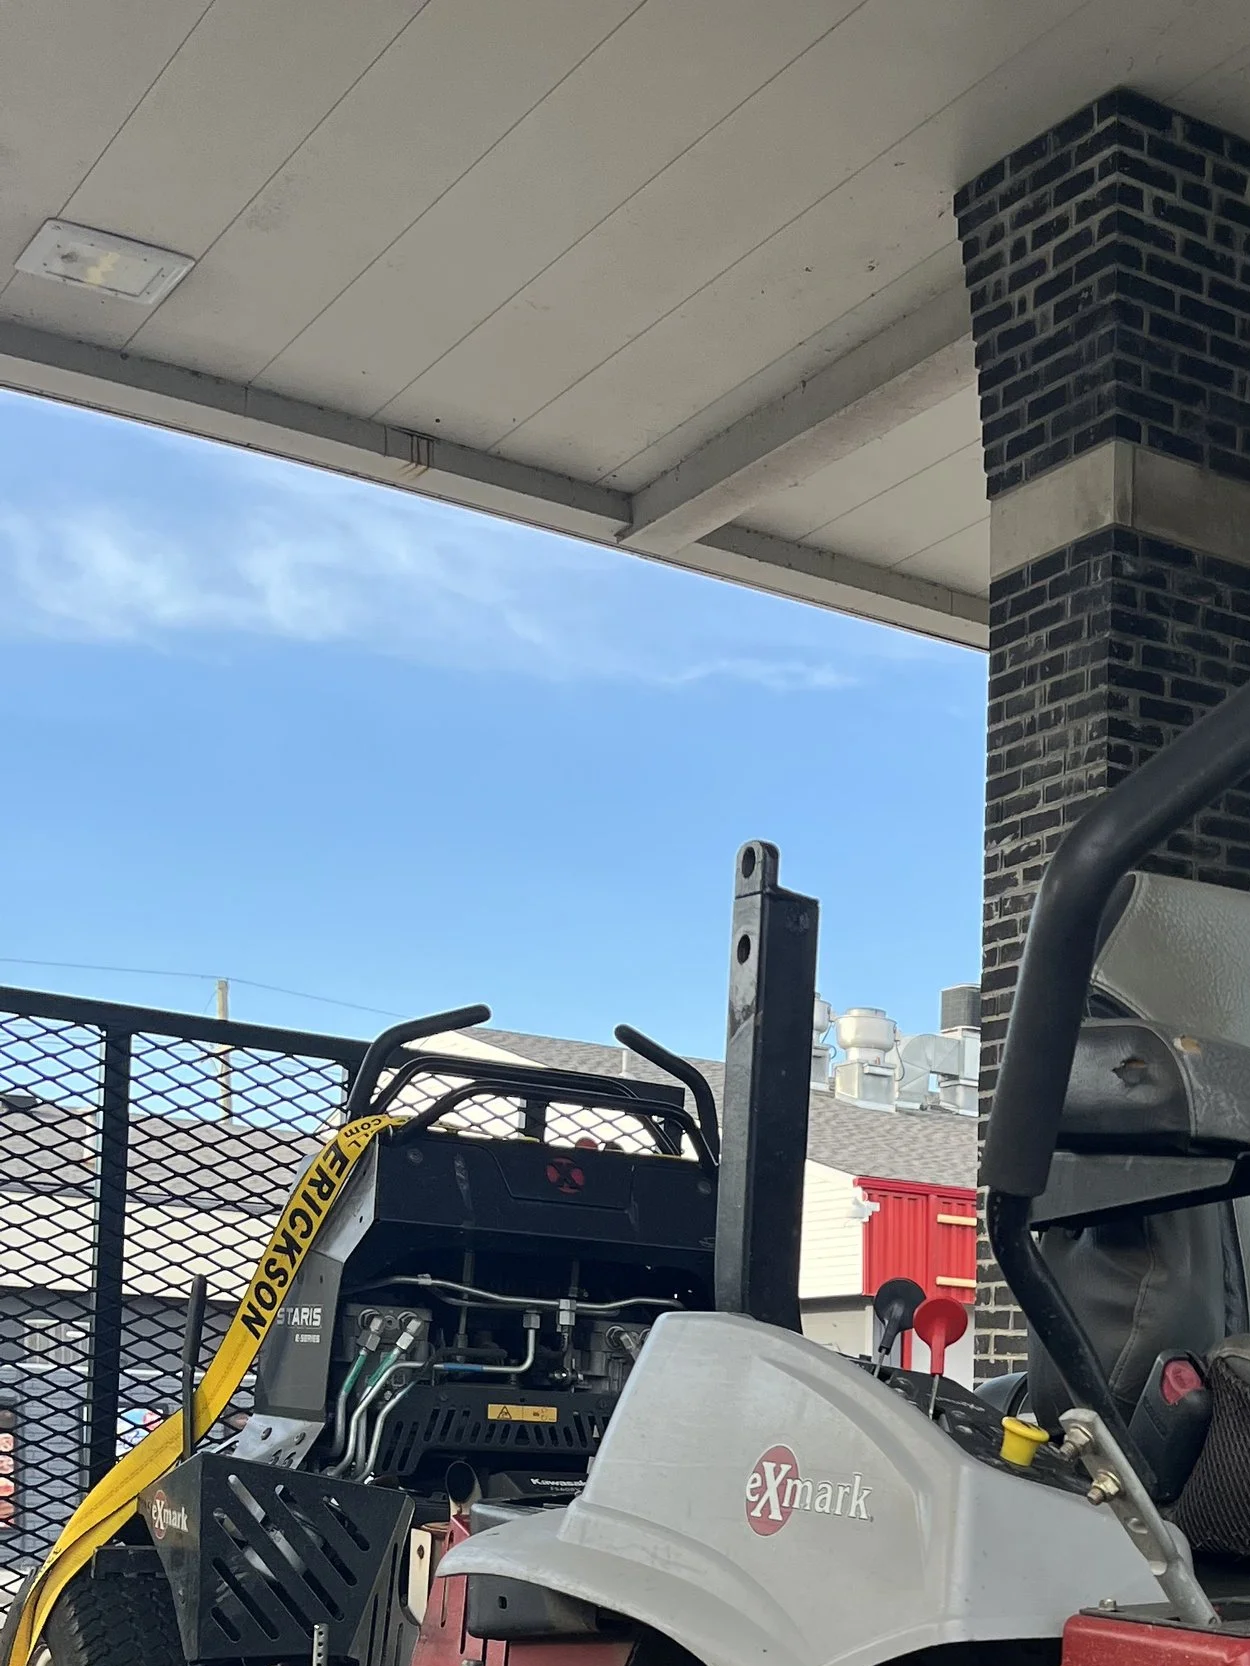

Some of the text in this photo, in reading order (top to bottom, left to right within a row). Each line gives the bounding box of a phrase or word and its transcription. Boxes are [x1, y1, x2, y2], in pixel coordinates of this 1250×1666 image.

[241, 1140, 349, 1340] ERICKSON
[152, 1499, 189, 1533] eXmark
[745, 1461, 873, 1522] eXmark
